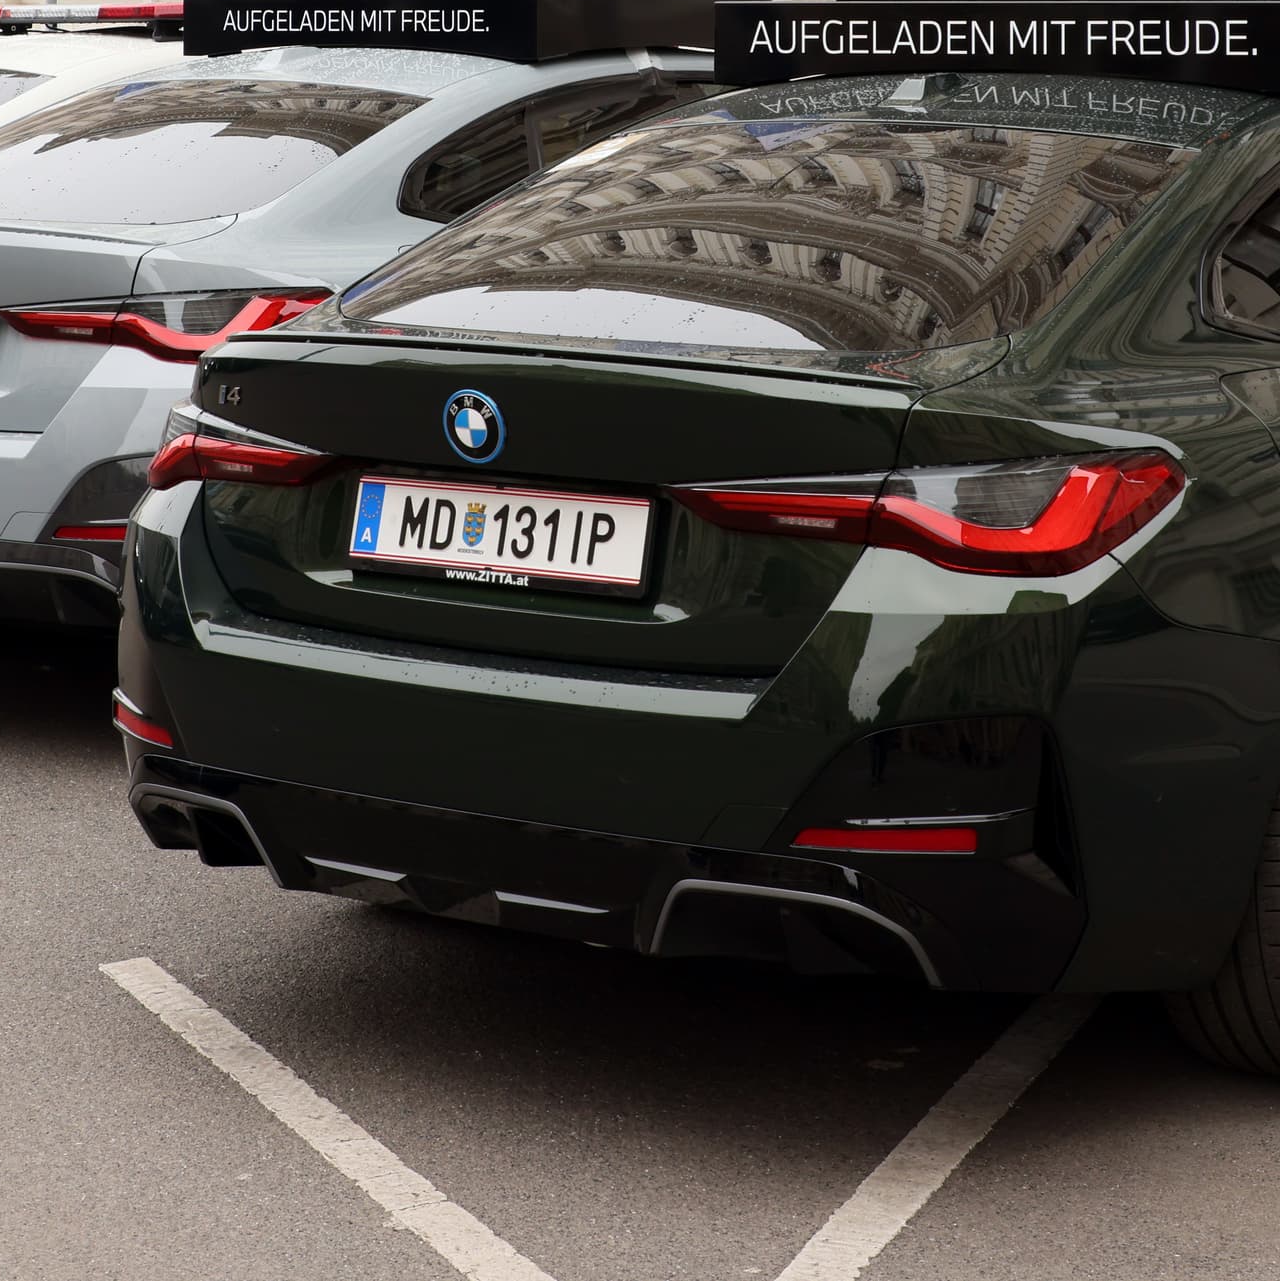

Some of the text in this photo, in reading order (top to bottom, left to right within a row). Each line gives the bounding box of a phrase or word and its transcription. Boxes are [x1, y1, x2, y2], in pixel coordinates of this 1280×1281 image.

[222, 9, 491, 34] AUFGELADEN MIT FREUDE.
[749, 19, 1259, 58] AUFGELADEN MIT FREUDE.
[449, 395, 493, 420] BMW
[359, 527, 373, 544] A
[398, 495, 617, 566] MD 131 IP
[445, 568, 529, 587] www.ZITTA.at
